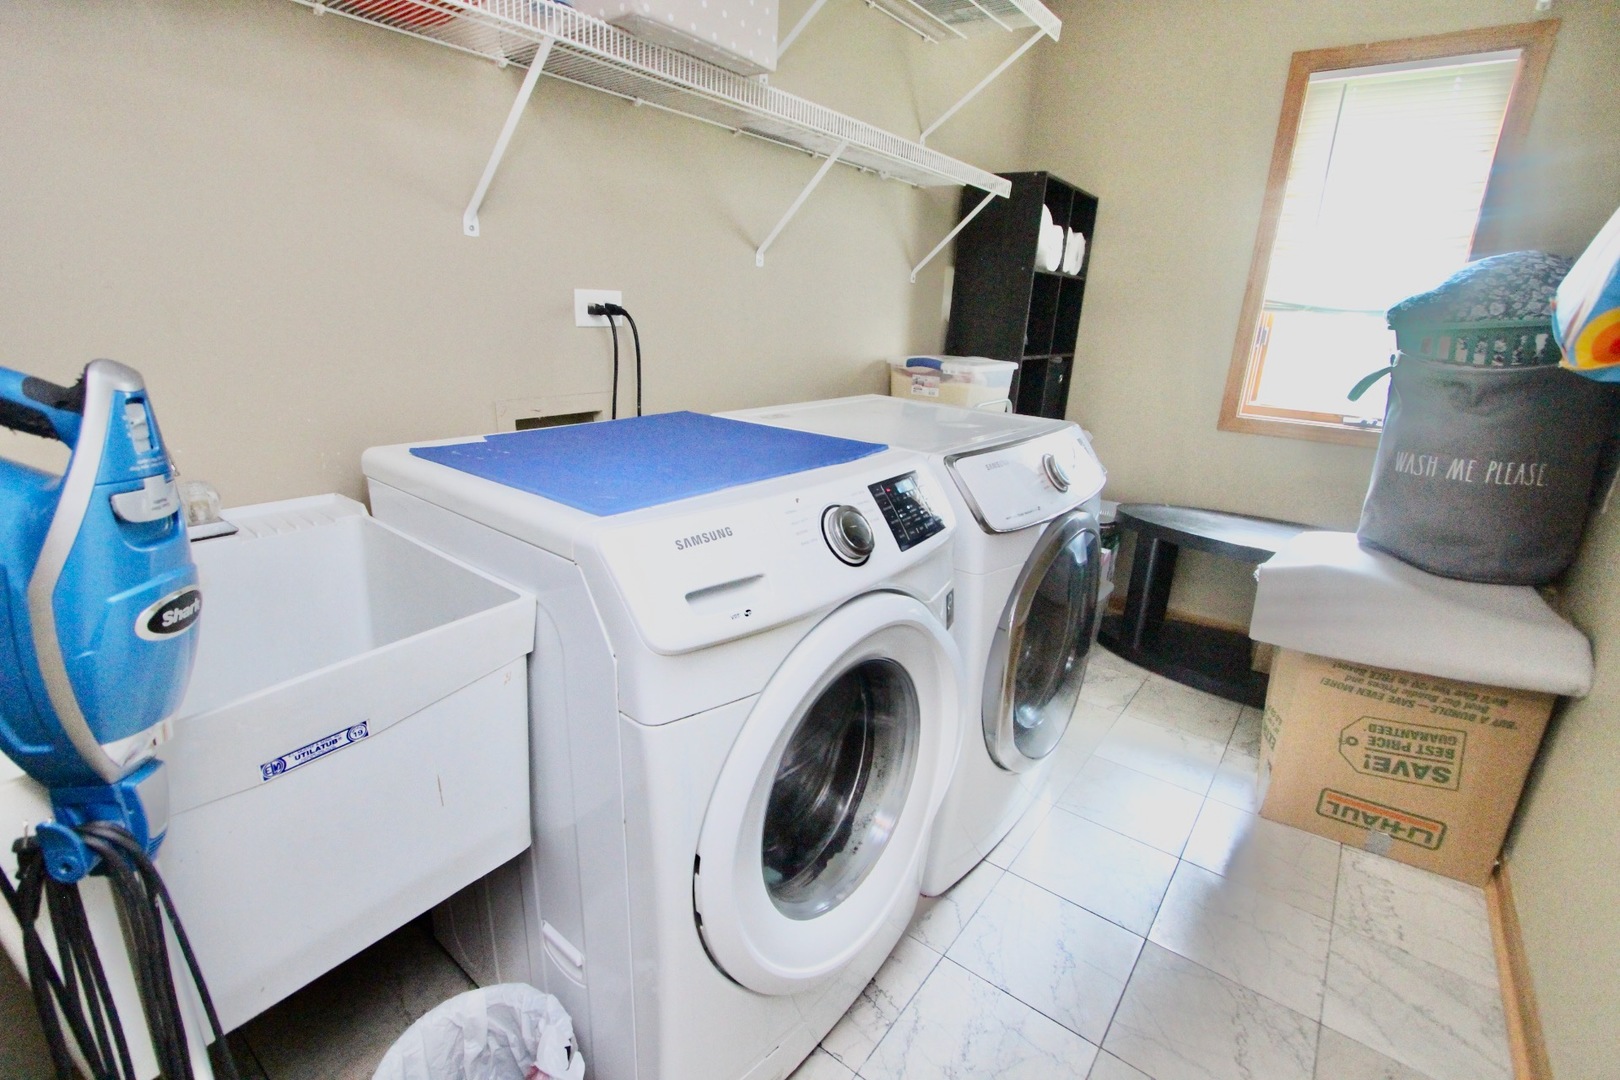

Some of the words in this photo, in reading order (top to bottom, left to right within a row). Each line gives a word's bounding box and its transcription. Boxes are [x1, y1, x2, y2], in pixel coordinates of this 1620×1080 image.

[1395, 452, 1438, 477] WASH
[1446, 458, 1477, 483] ME
[1485, 460, 1547, 487] PLEASE
[675, 526, 733, 550] SAMSUNG
[162, 597, 200, 627] Shark
[1320, 676, 1354, 693] MORE!
[1344, 674, 1364, 685] and
[1366, 680, 1399, 695] Prices
[1355, 687, 1385, 701] EVEN
[1388, 695, 1416, 709] SAVE
[1429, 704, 1476, 723] BUNDLE
[1479, 714, 1490, 725] A
[353, 728, 363, 738] 19
[1367, 735, 1411, 753] PRICE
[1415, 745, 1456, 760] BEST
[1363, 753, 1453, 784] SAVE!
[1326, 800, 1434, 844] U-HAUL
